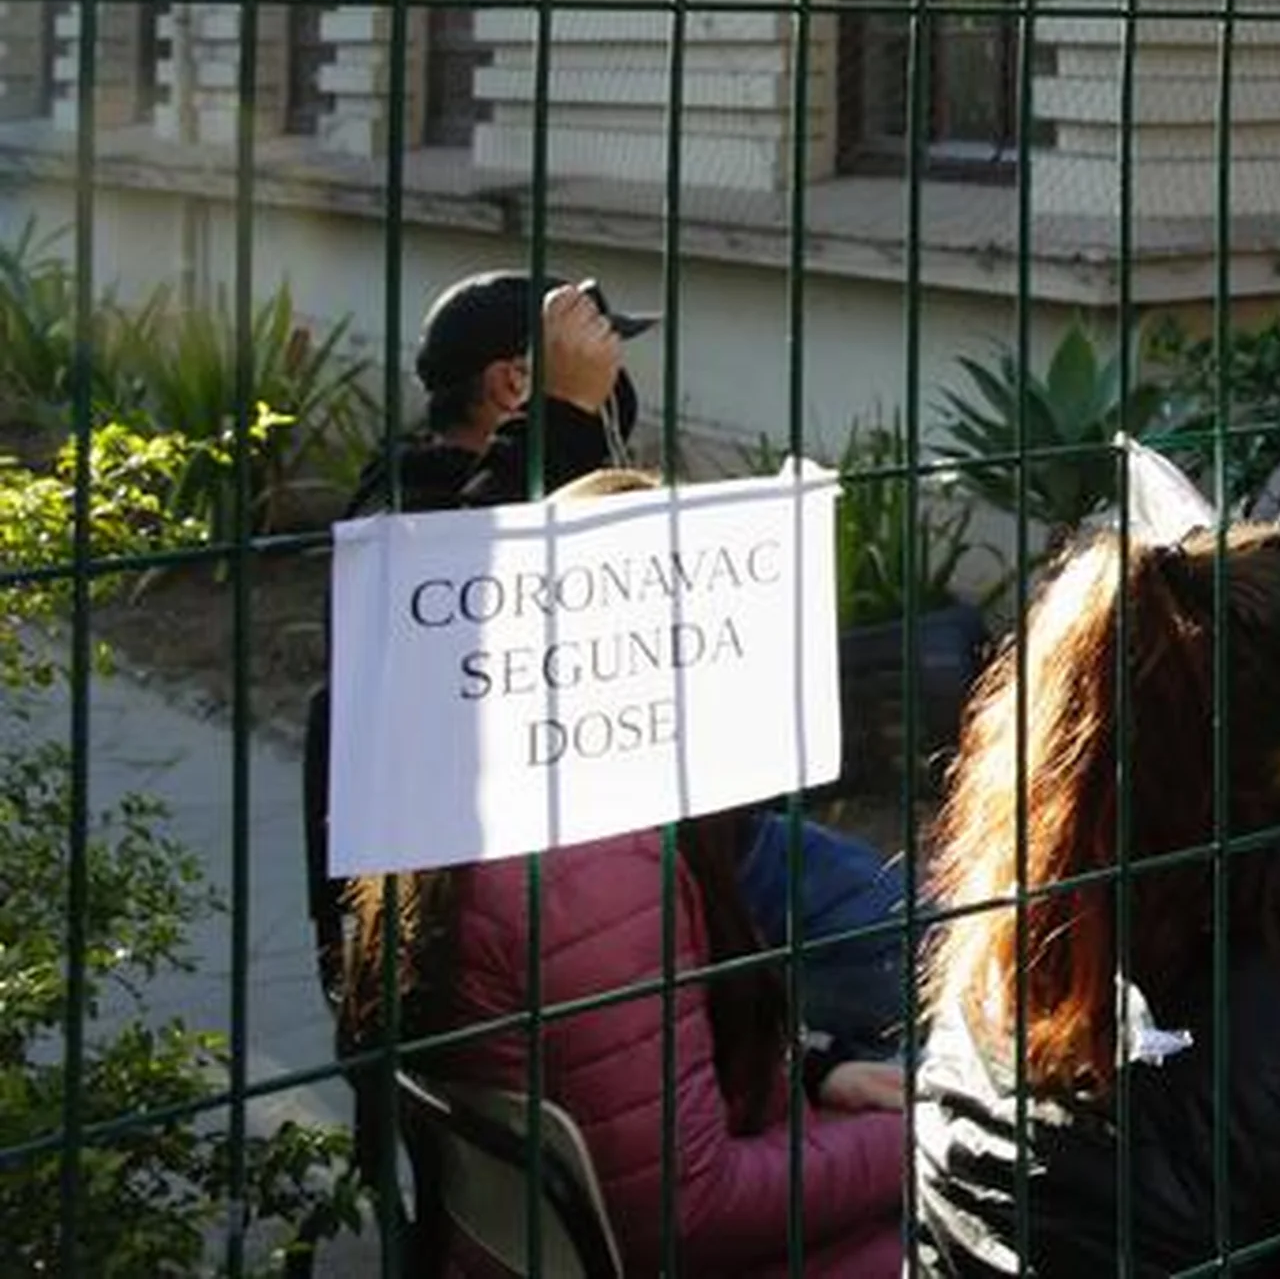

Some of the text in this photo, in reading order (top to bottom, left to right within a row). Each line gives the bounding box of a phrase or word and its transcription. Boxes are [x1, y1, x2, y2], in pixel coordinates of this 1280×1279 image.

[410, 538, 783, 628] CORONAVAC
[458, 616, 745, 700] SEGUNDA
[526, 698, 682, 768] DOSE
